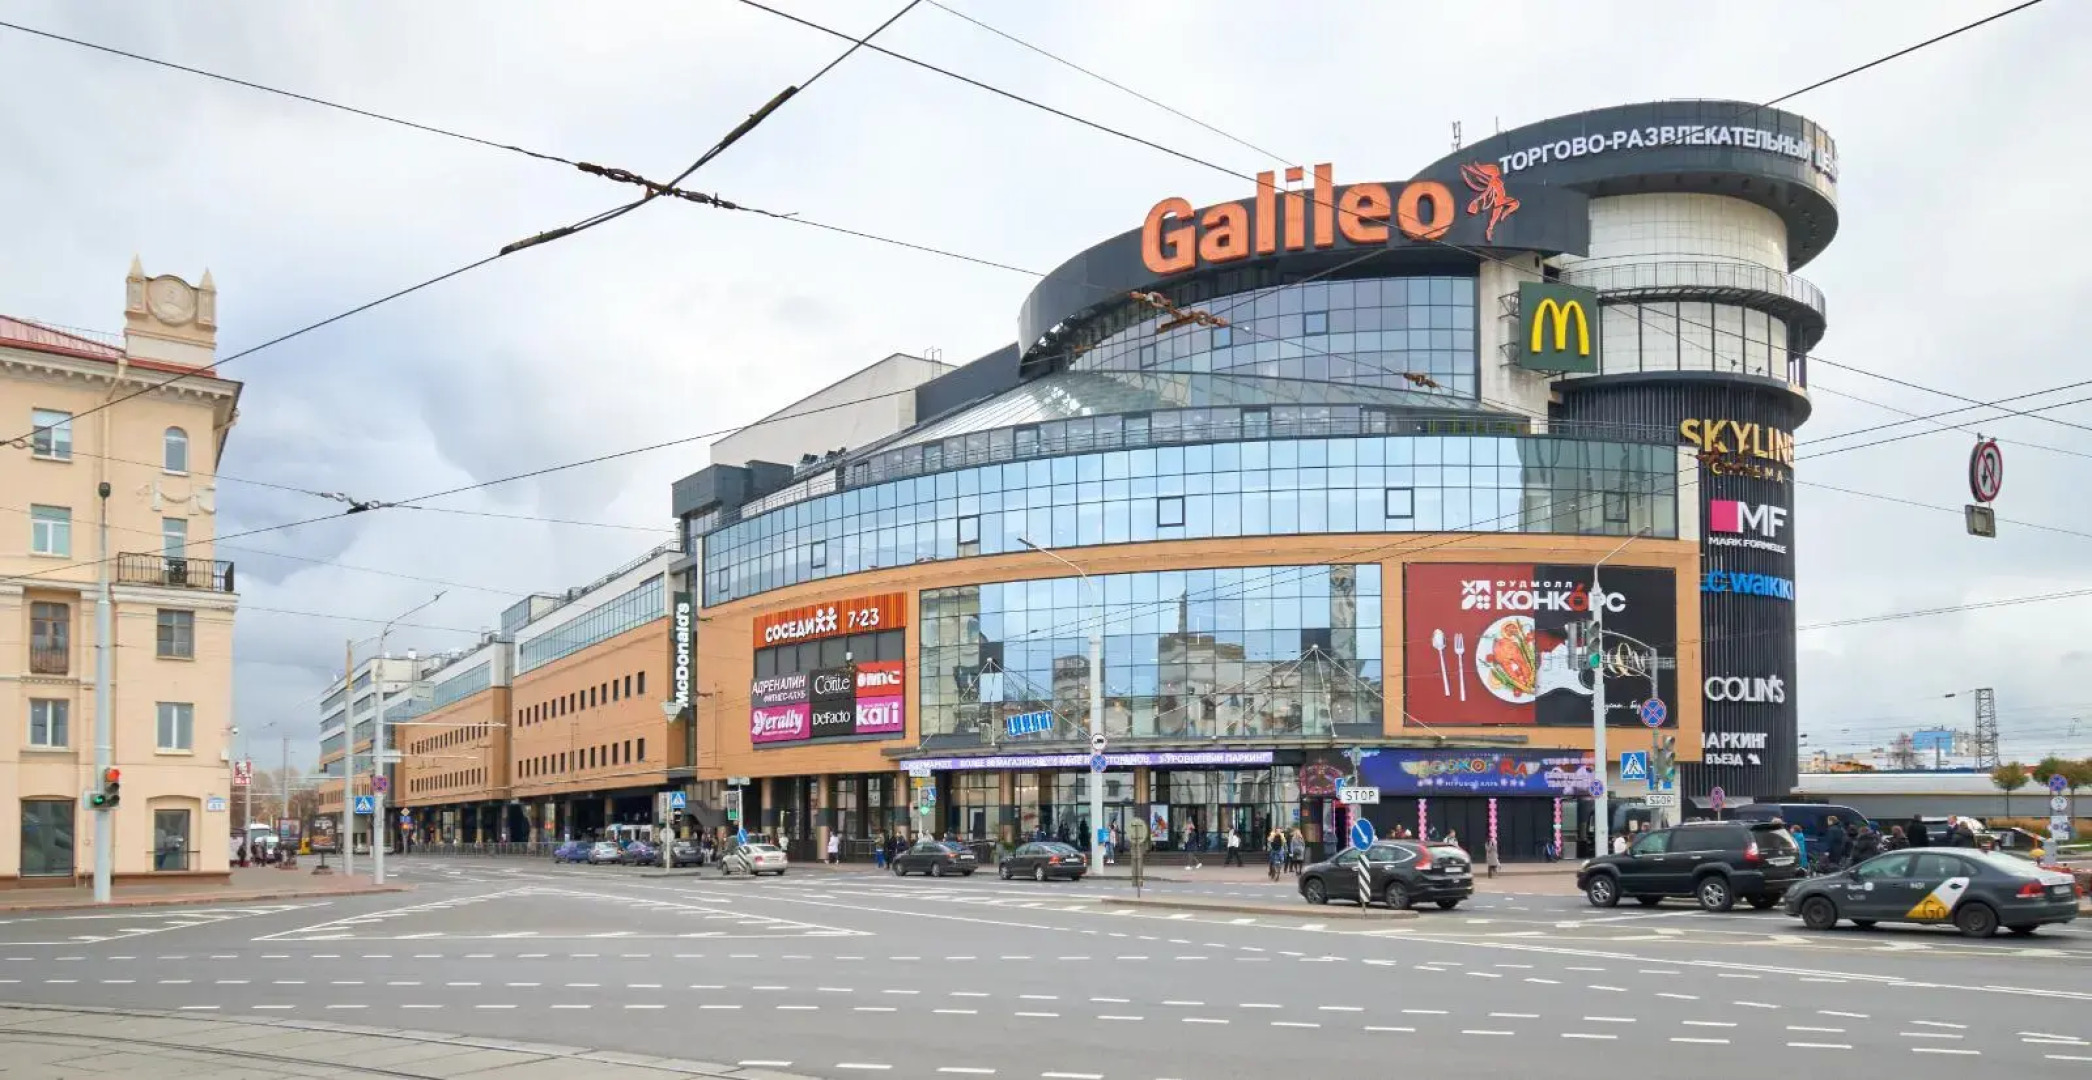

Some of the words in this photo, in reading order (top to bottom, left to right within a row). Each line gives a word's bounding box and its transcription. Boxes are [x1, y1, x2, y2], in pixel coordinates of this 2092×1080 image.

[1499, 125, 1812, 174] ТОРГОВО-РАЗВЛЕКАТЕЛЬНЫЙ
[1142, 164, 1456, 274] Galileo
[1680, 418, 1795, 470] SKYLINE
[1737, 501, 1788, 537] MF
[1708, 537, 1743, 547] MARK
[1497, 580, 1572, 588] ФУДМОЛЛ
[751, 675, 806, 697] АДРЕНАЛИН
[815, 674, 850, 695] Conte
[1704, 675, 1785, 704] COLIN'S
[857, 701, 899, 726] kari
[1705, 752, 1743, 766] ВЪЕЗД
[1346, 790, 1375, 801] STOP
